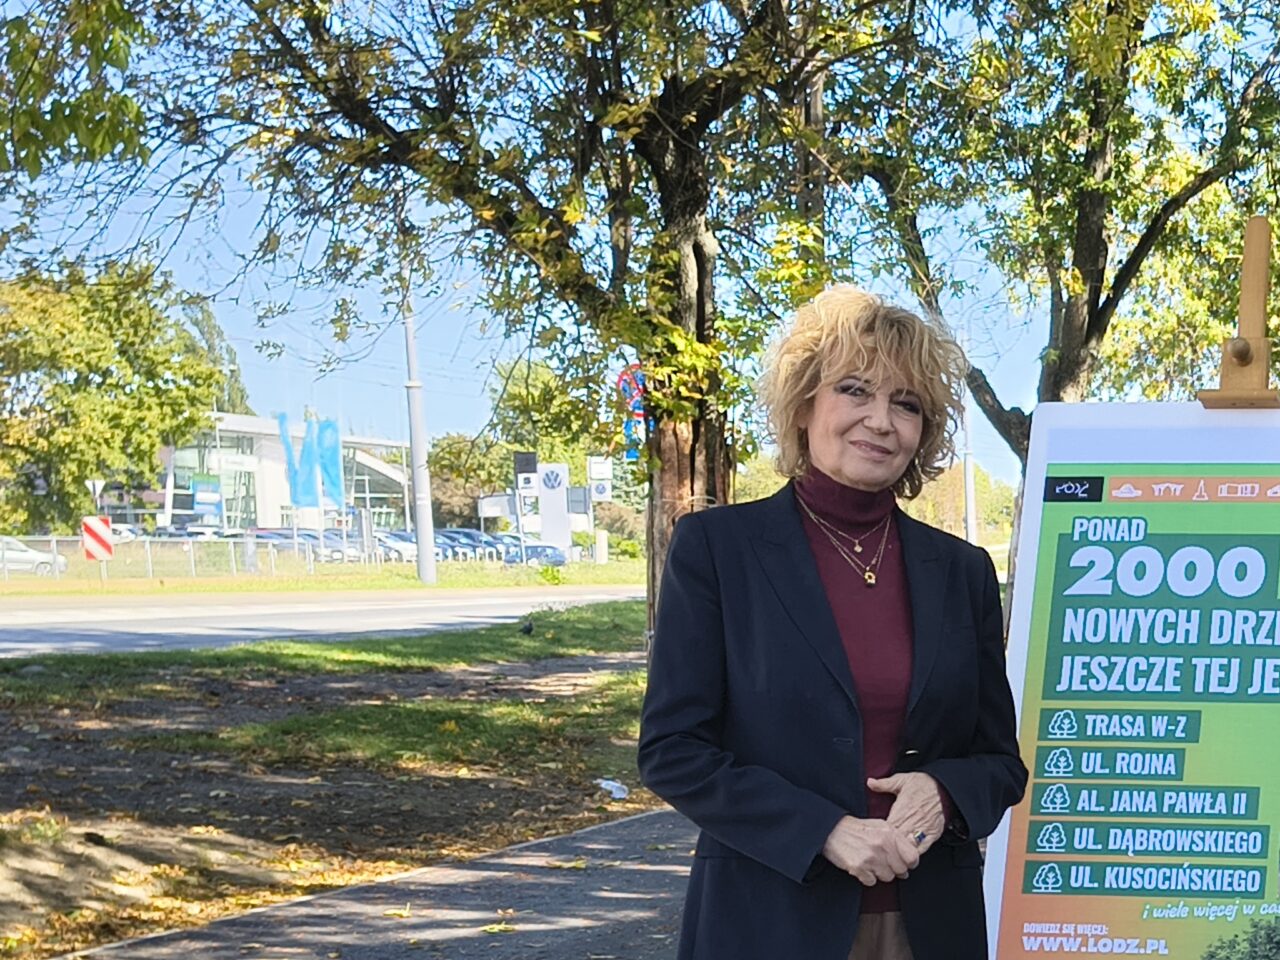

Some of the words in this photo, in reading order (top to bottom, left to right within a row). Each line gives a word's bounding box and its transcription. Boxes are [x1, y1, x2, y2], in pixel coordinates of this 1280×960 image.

[1072, 518, 1147, 542] PONAD
[1063, 546, 1267, 597] 2000
[1062, 607, 1199, 645] NOWYCH
[1056, 656, 1184, 693] JESZCZE
[1192, 657, 1240, 695] TEJ
[1085, 714, 1146, 737] TRASA
[1151, 715, 1187, 738] W-Z
[1081, 752, 1110, 774] UL.
[1115, 752, 1176, 775] ROJNA
[1076, 789, 1105, 811] AL.
[1109, 790, 1157, 813] JANA
[1162, 791, 1228, 814] PAWŁA
[1232, 792, 1247, 815] II
[1073, 827, 1102, 850] UL.
[1107, 828, 1262, 857] DĄBROWSKIEGO
[1069, 865, 1099, 888] UL.
[1104, 861, 1261, 892] KUSOCIŃSKIEGO
[1142, 905, 1150, 919] i
[1153, 902, 1188, 918] wiele
[1194, 901, 1239, 921] więcej
[1243, 904, 1256, 915] w
[1023, 923, 1061, 934] DOWIEDZ
[1062, 924, 1075, 937] SIĘ
[1022, 936, 1169, 955] WWW.LODZ.PL
